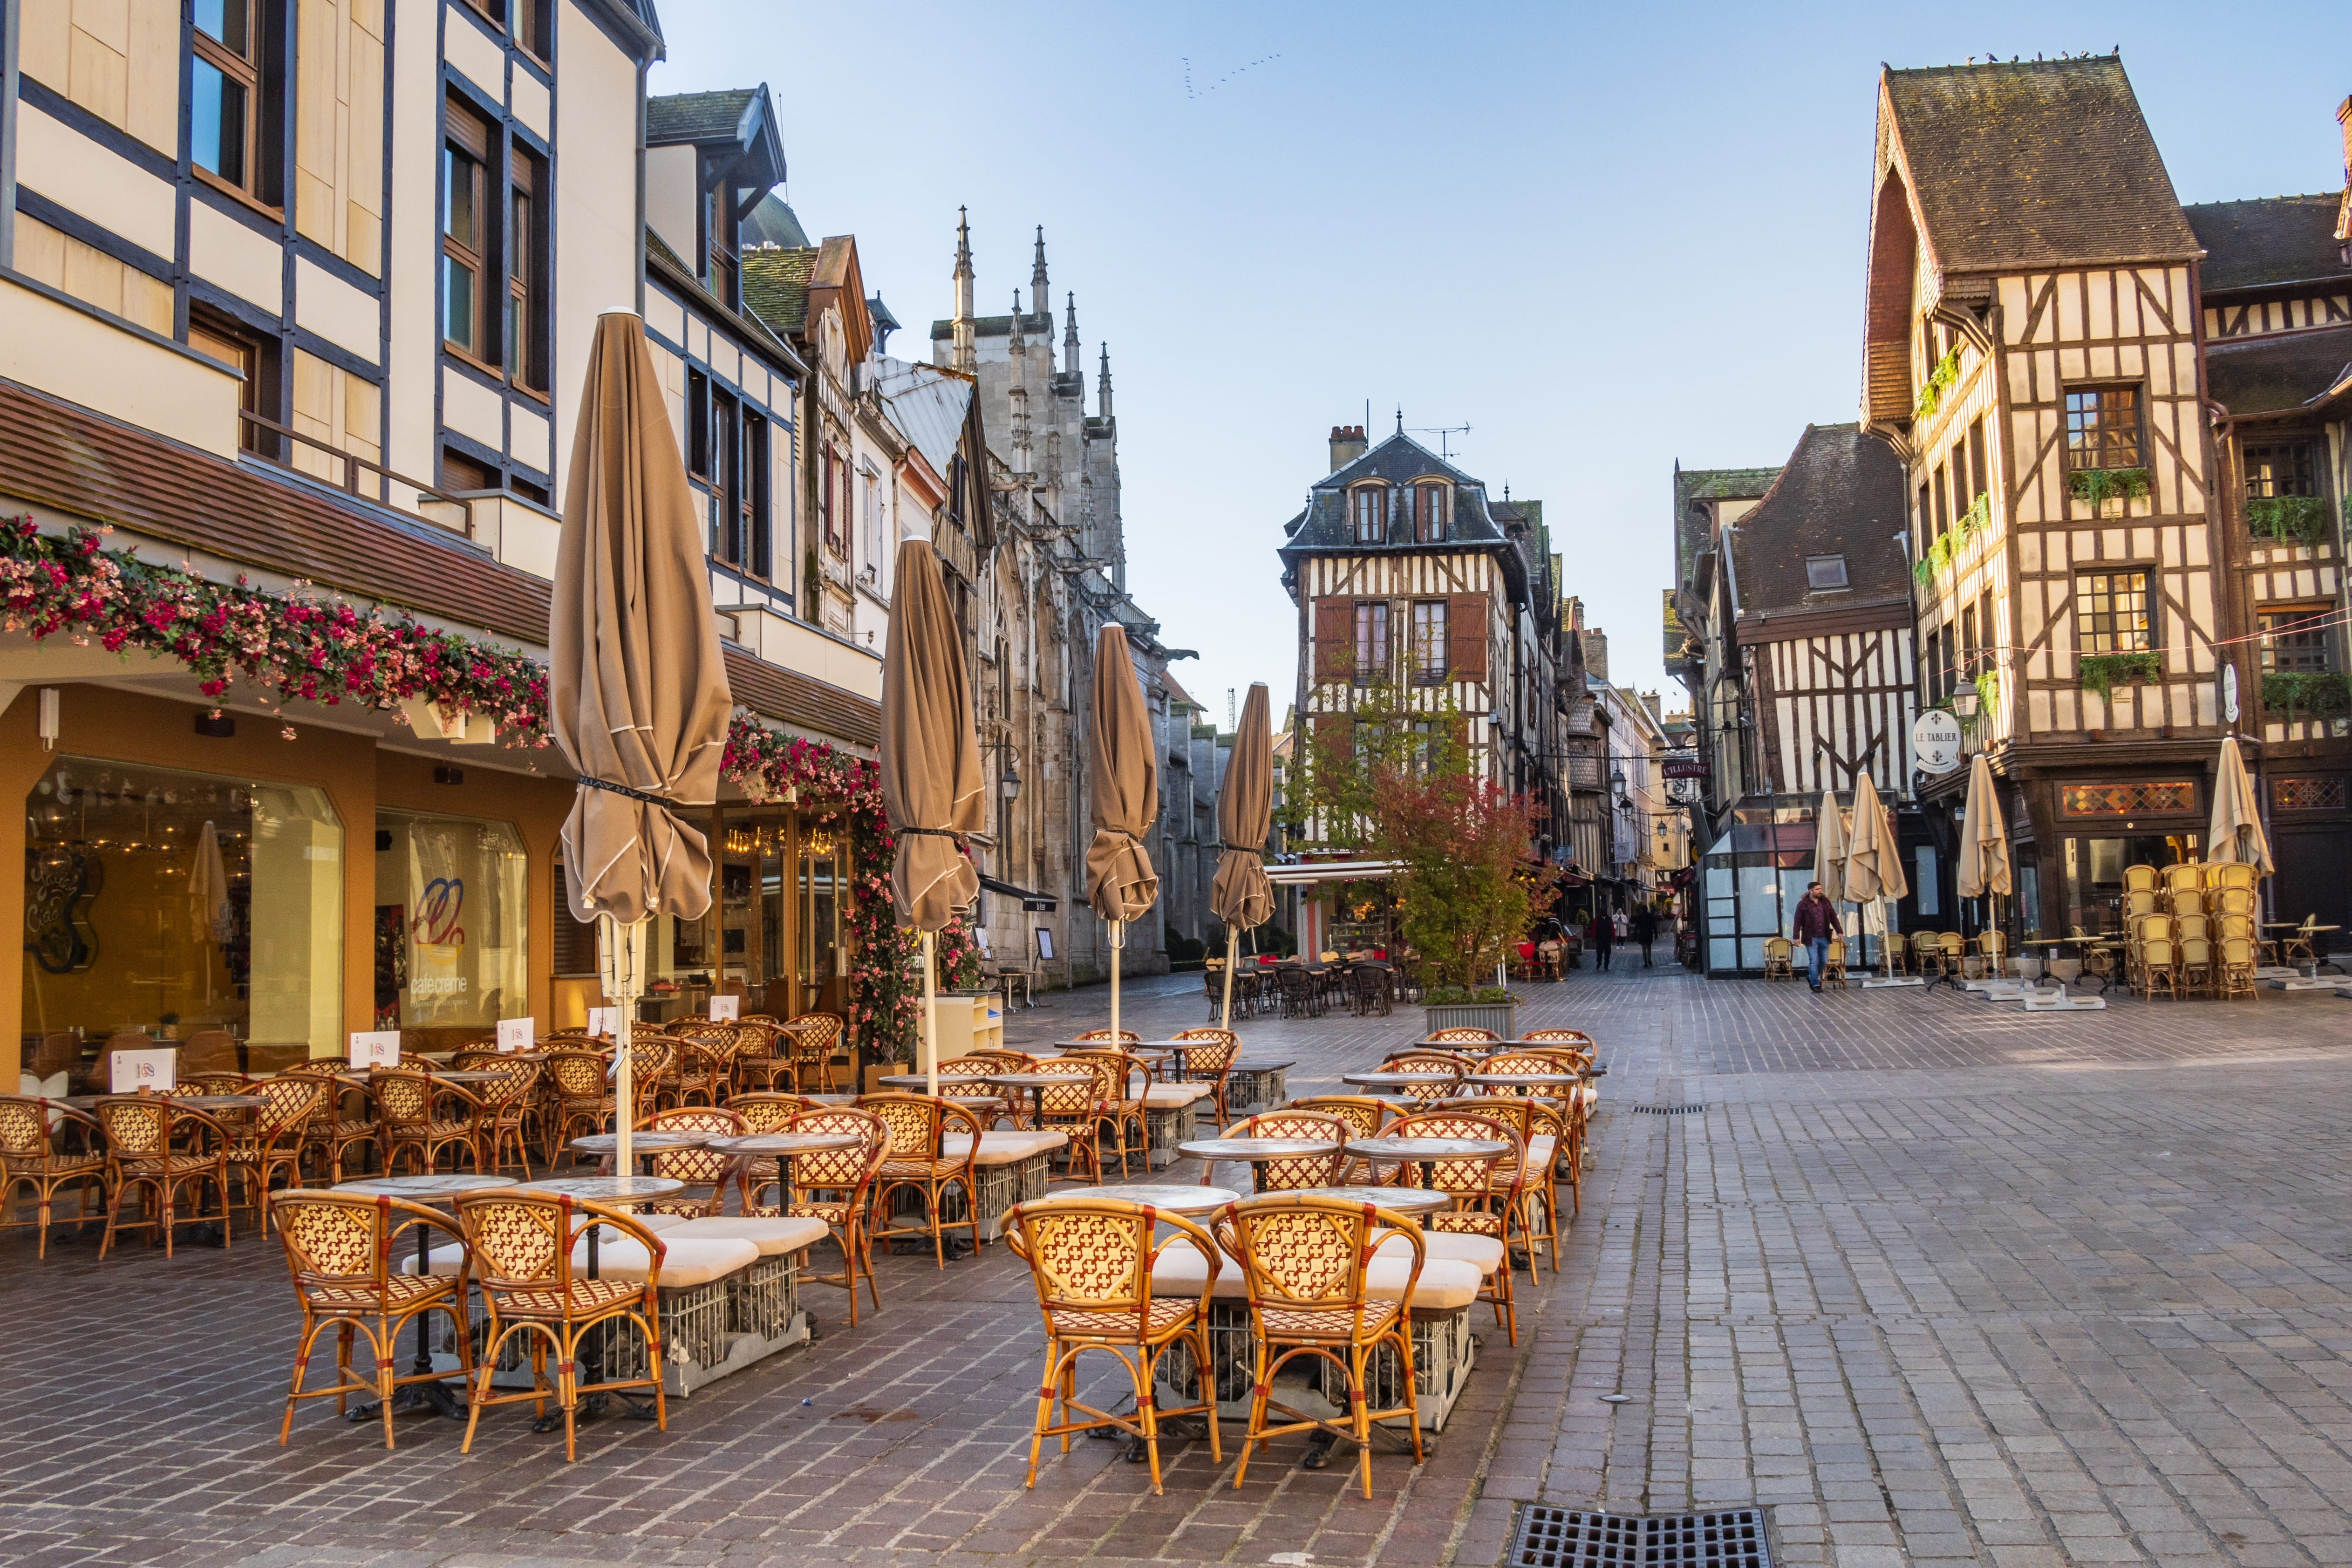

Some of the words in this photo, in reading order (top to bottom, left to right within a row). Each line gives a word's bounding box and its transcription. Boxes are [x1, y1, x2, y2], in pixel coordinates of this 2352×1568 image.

[1915, 733, 1925, 742] LE
[1927, 732, 1957, 742] TABLIER
[1663, 764, 1708, 776] L'ILLUSTRÉ
[579, 776, 651, 801] CARAVITA
